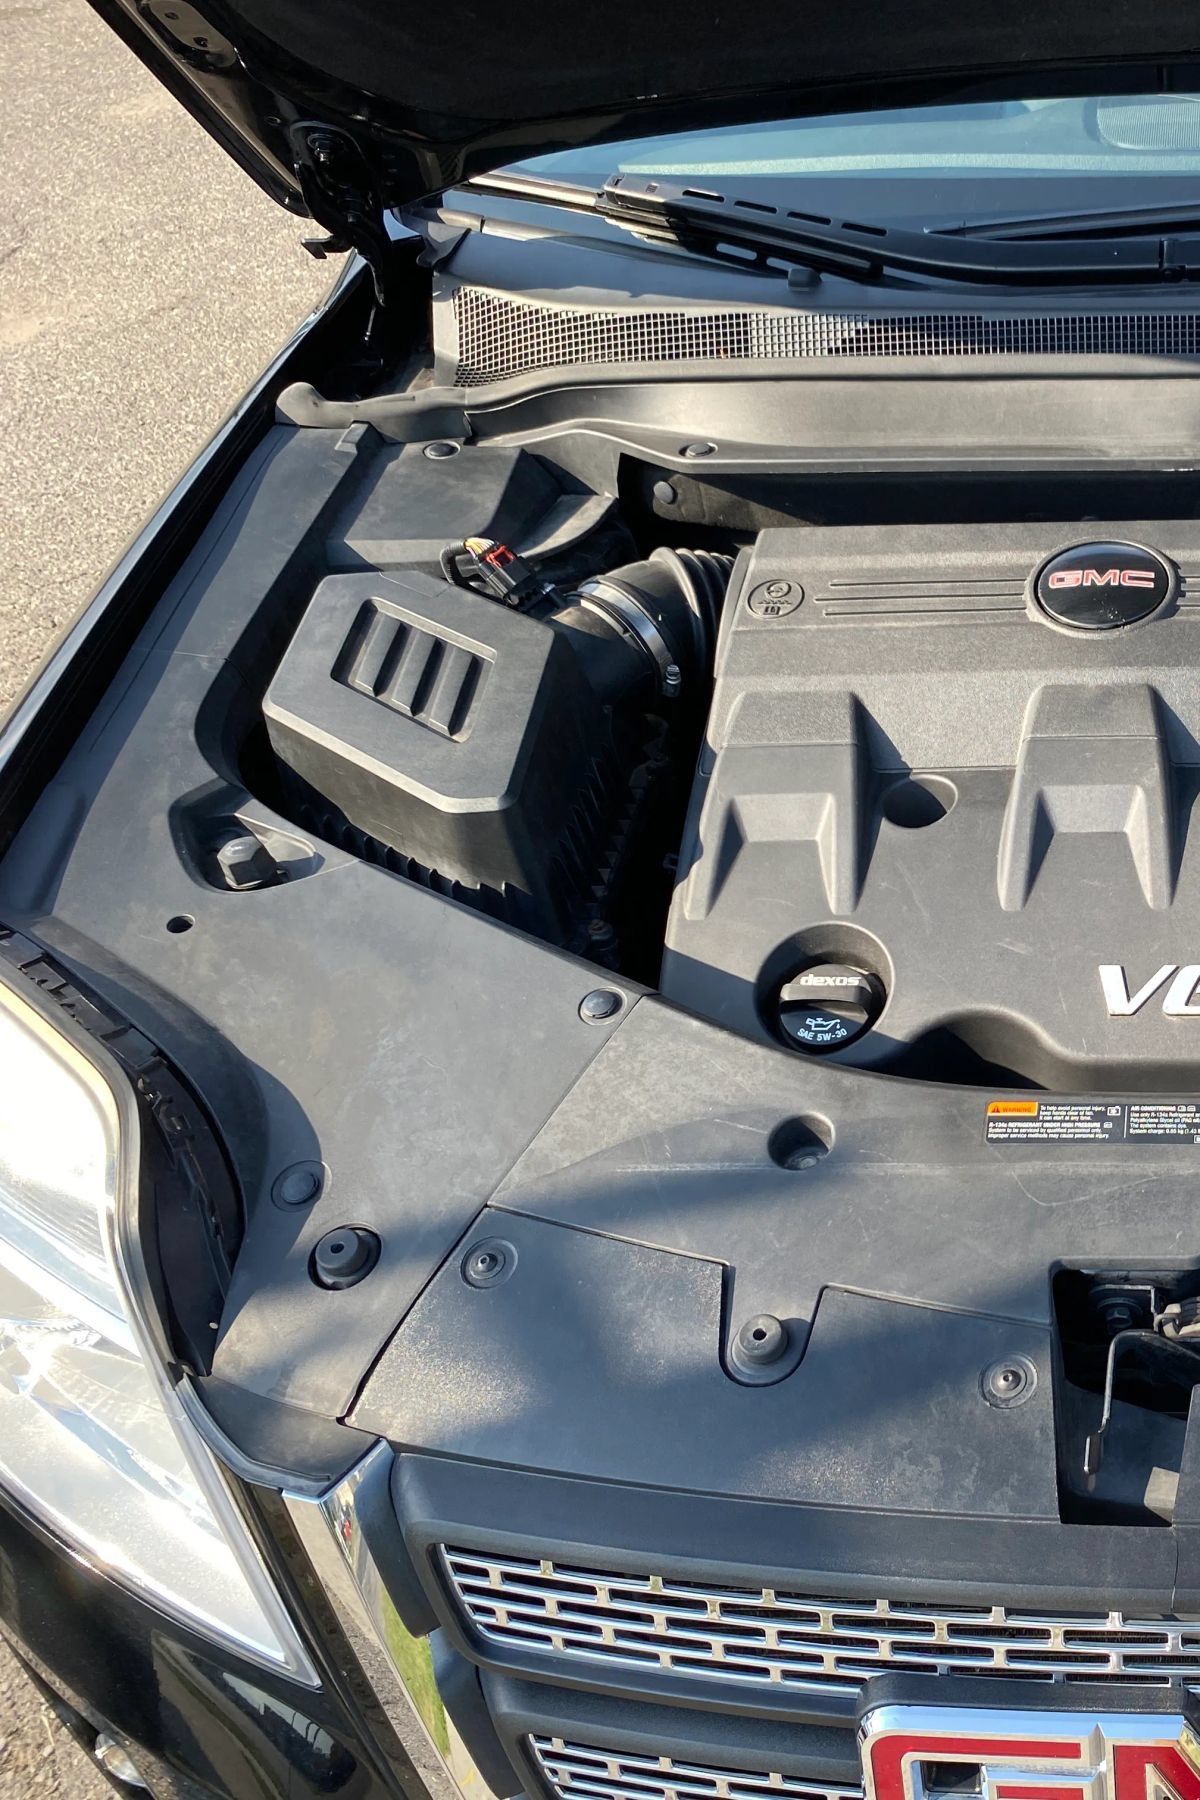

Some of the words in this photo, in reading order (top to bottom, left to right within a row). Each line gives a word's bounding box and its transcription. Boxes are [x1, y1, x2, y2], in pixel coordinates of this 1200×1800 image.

[1048, 569, 1155, 589] GMC
[800, 973, 862, 987] dexos
[797, 1028, 814, 1041] SAE
[816, 1028, 848, 1042] 5W-30
